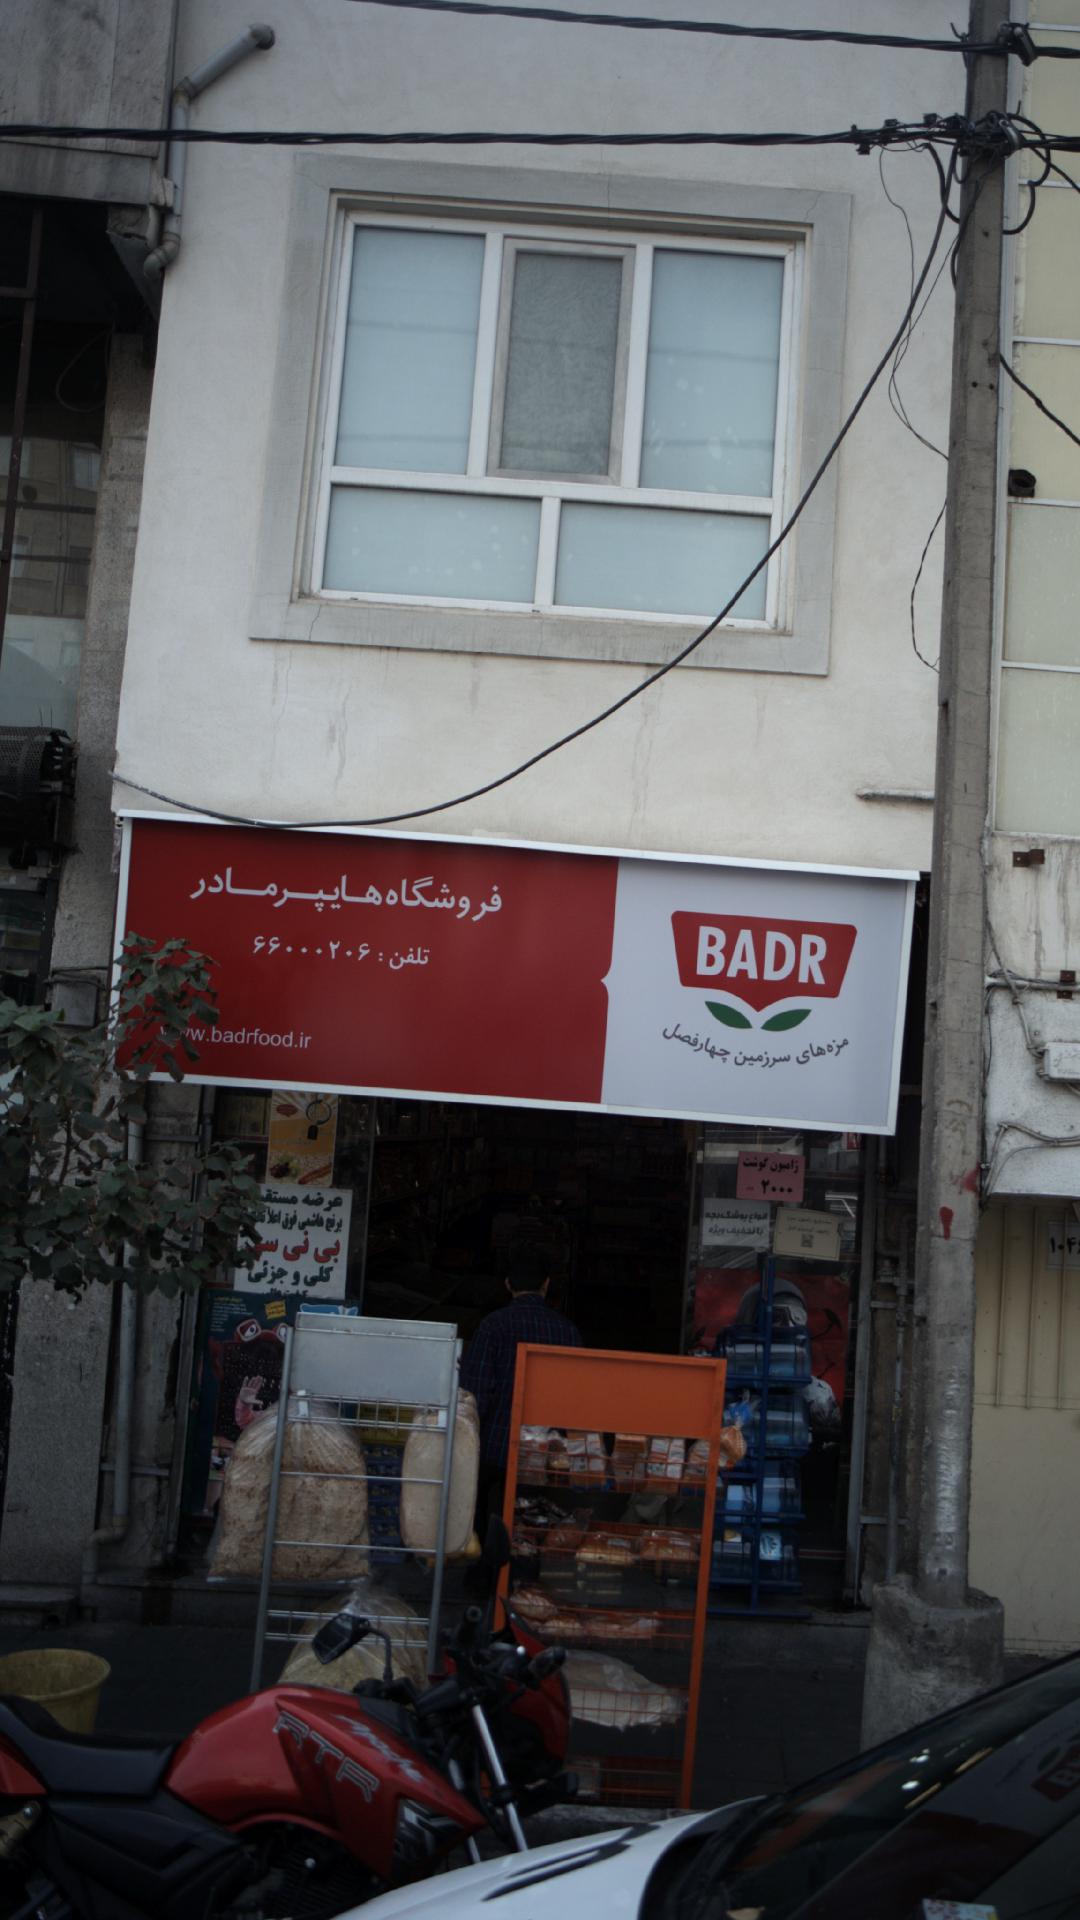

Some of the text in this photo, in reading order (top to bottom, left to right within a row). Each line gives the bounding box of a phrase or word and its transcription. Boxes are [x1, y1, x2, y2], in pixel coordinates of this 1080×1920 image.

[386, 875, 503, 922] فروشگاه
[252, 935, 371, 961] ۶۶۰۰۰۲۰۶
[696, 925, 828, 985] BADR
[734, 1048, 791, 1067] سرزمین
[742, 1157, 799, 1174] ژامبون گوشت
[302, 1191, 343, 1211] عرضه
[281, 1209, 297, 1230] فوق
[297, 1211, 324, 1231] هاشمی
[324, 1213, 342, 1232] برنج
[282, 1230, 310, 1262] نی
[314, 1239, 341, 1264] بی
[247, 1260, 334, 1287] کلی و جزئی
[272, 1709, 380, 1804] RTR
